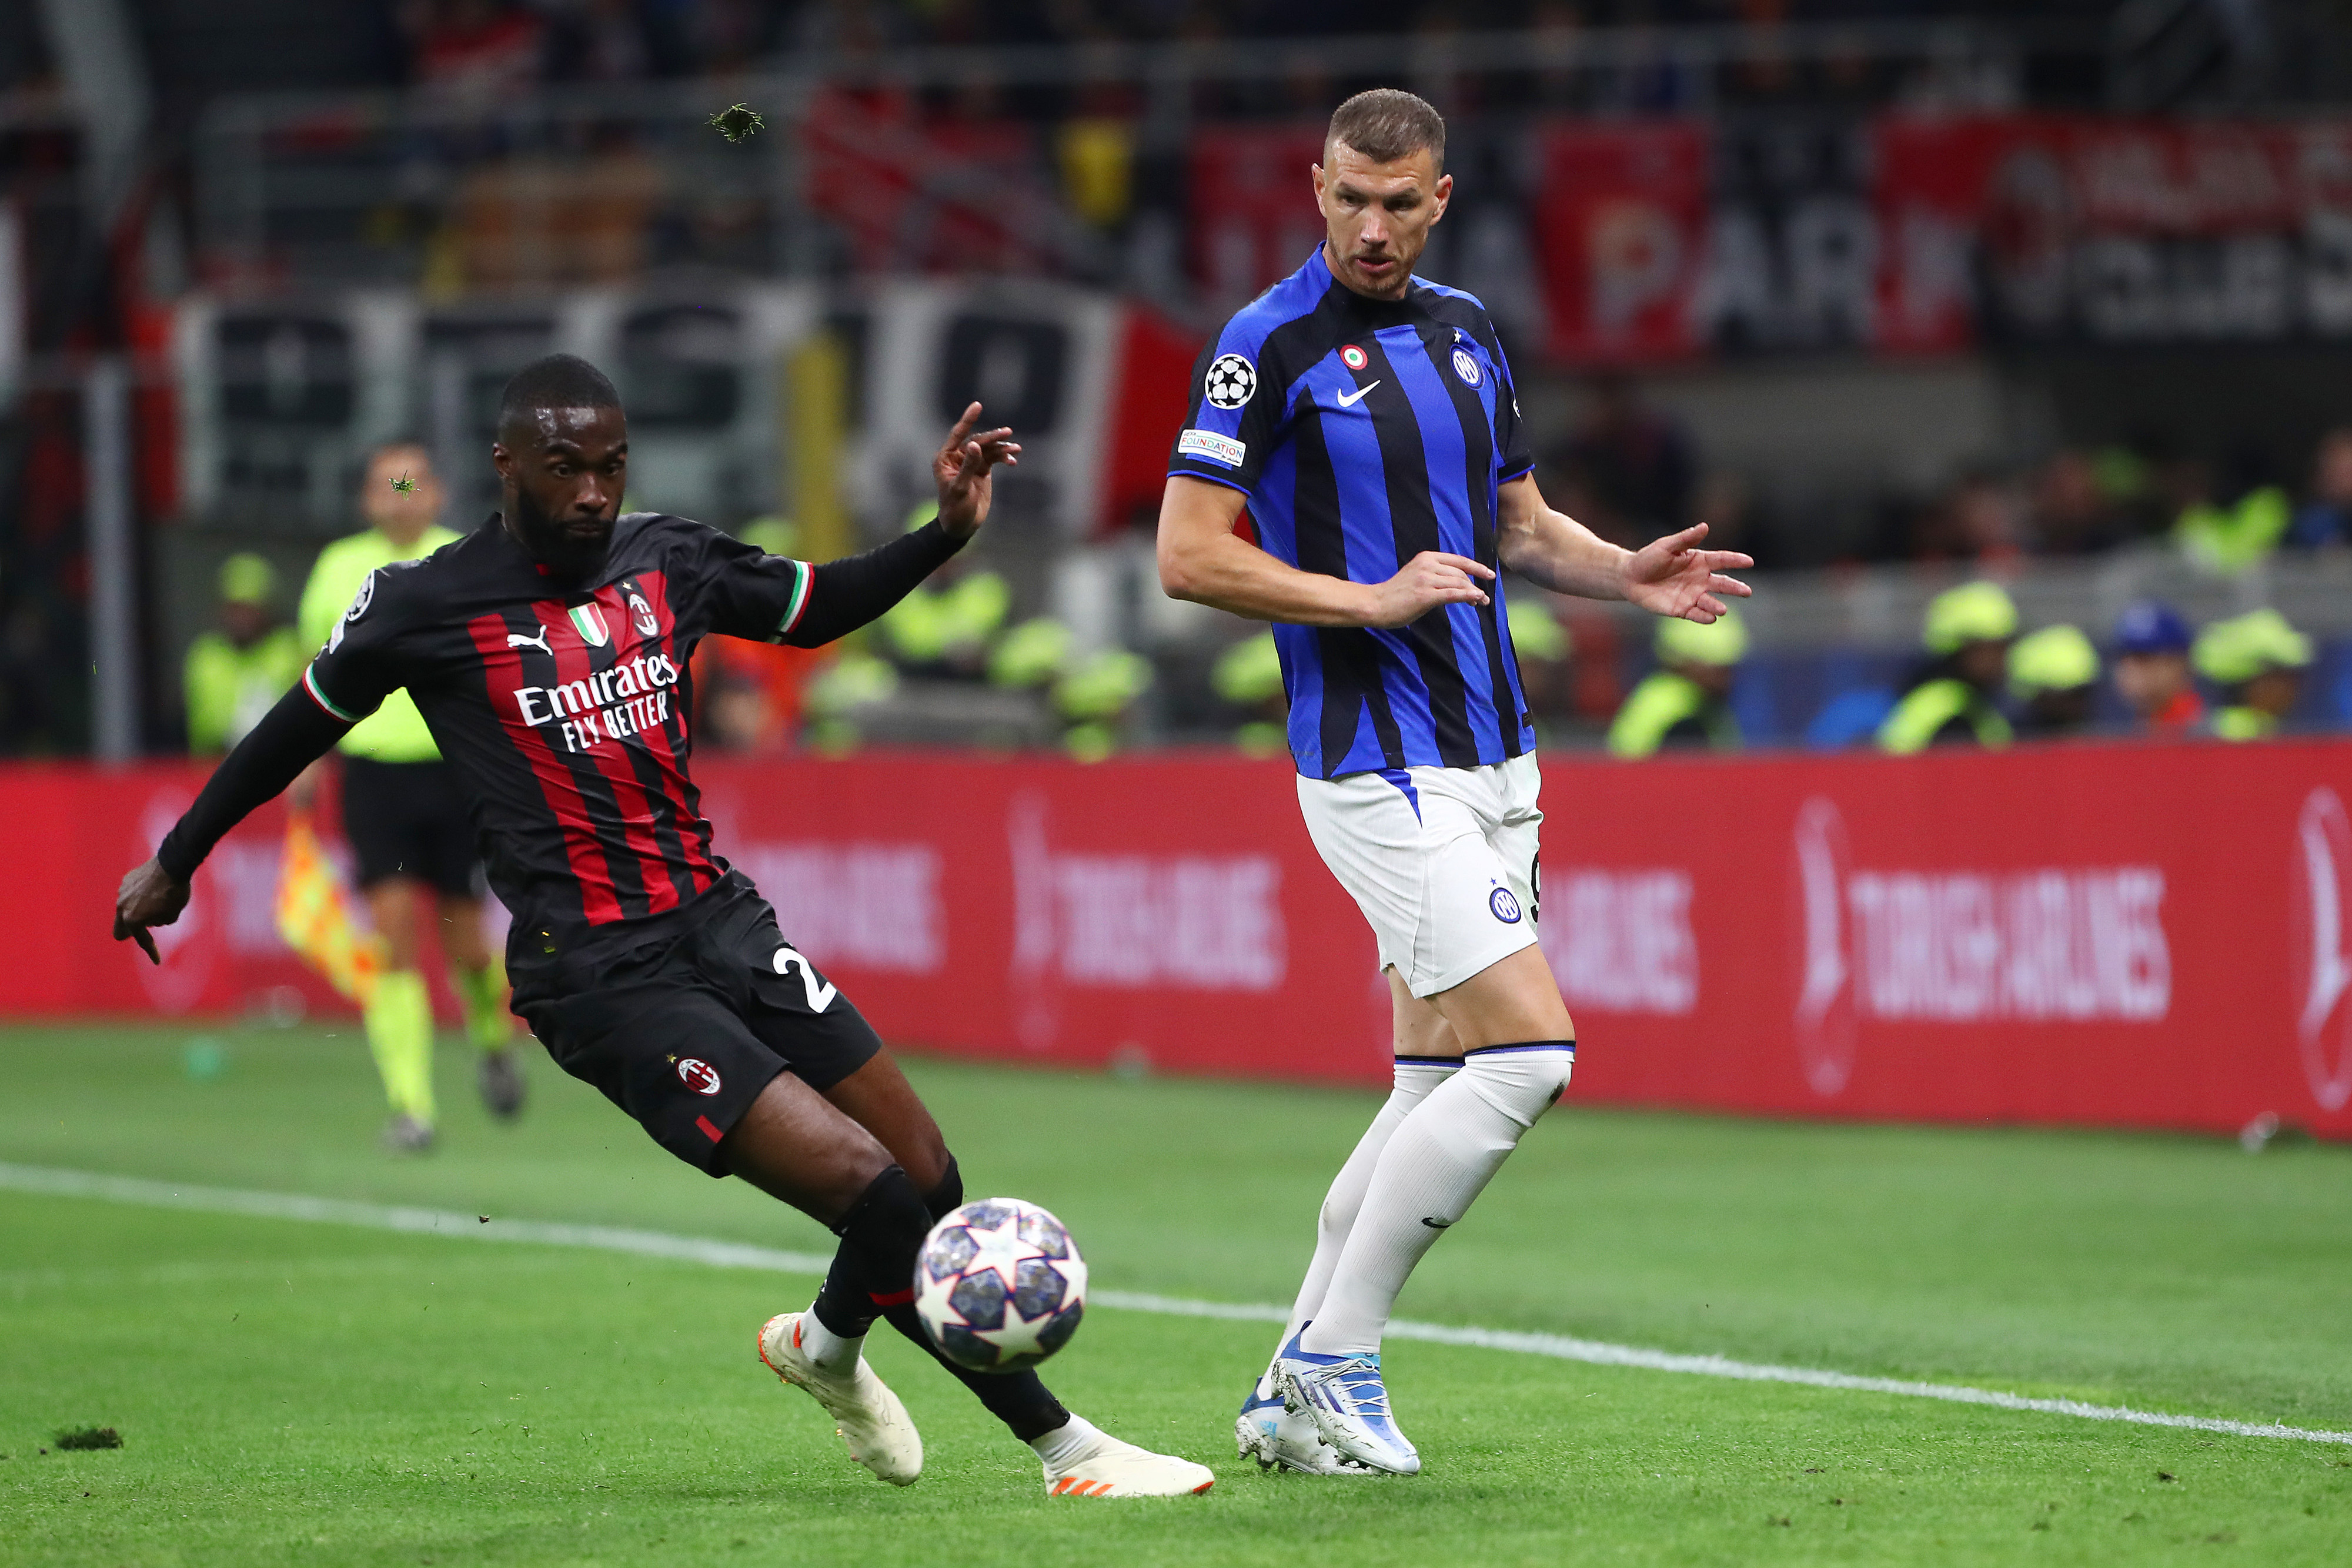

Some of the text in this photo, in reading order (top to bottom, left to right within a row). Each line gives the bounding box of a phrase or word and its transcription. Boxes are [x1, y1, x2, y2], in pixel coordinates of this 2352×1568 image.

[1181, 437, 1243, 458] FOUNDATION
[513, 654, 677, 727] Emirates
[562, 690, 669, 753] FLY BETTER
[773, 948, 837, 1013] 2
